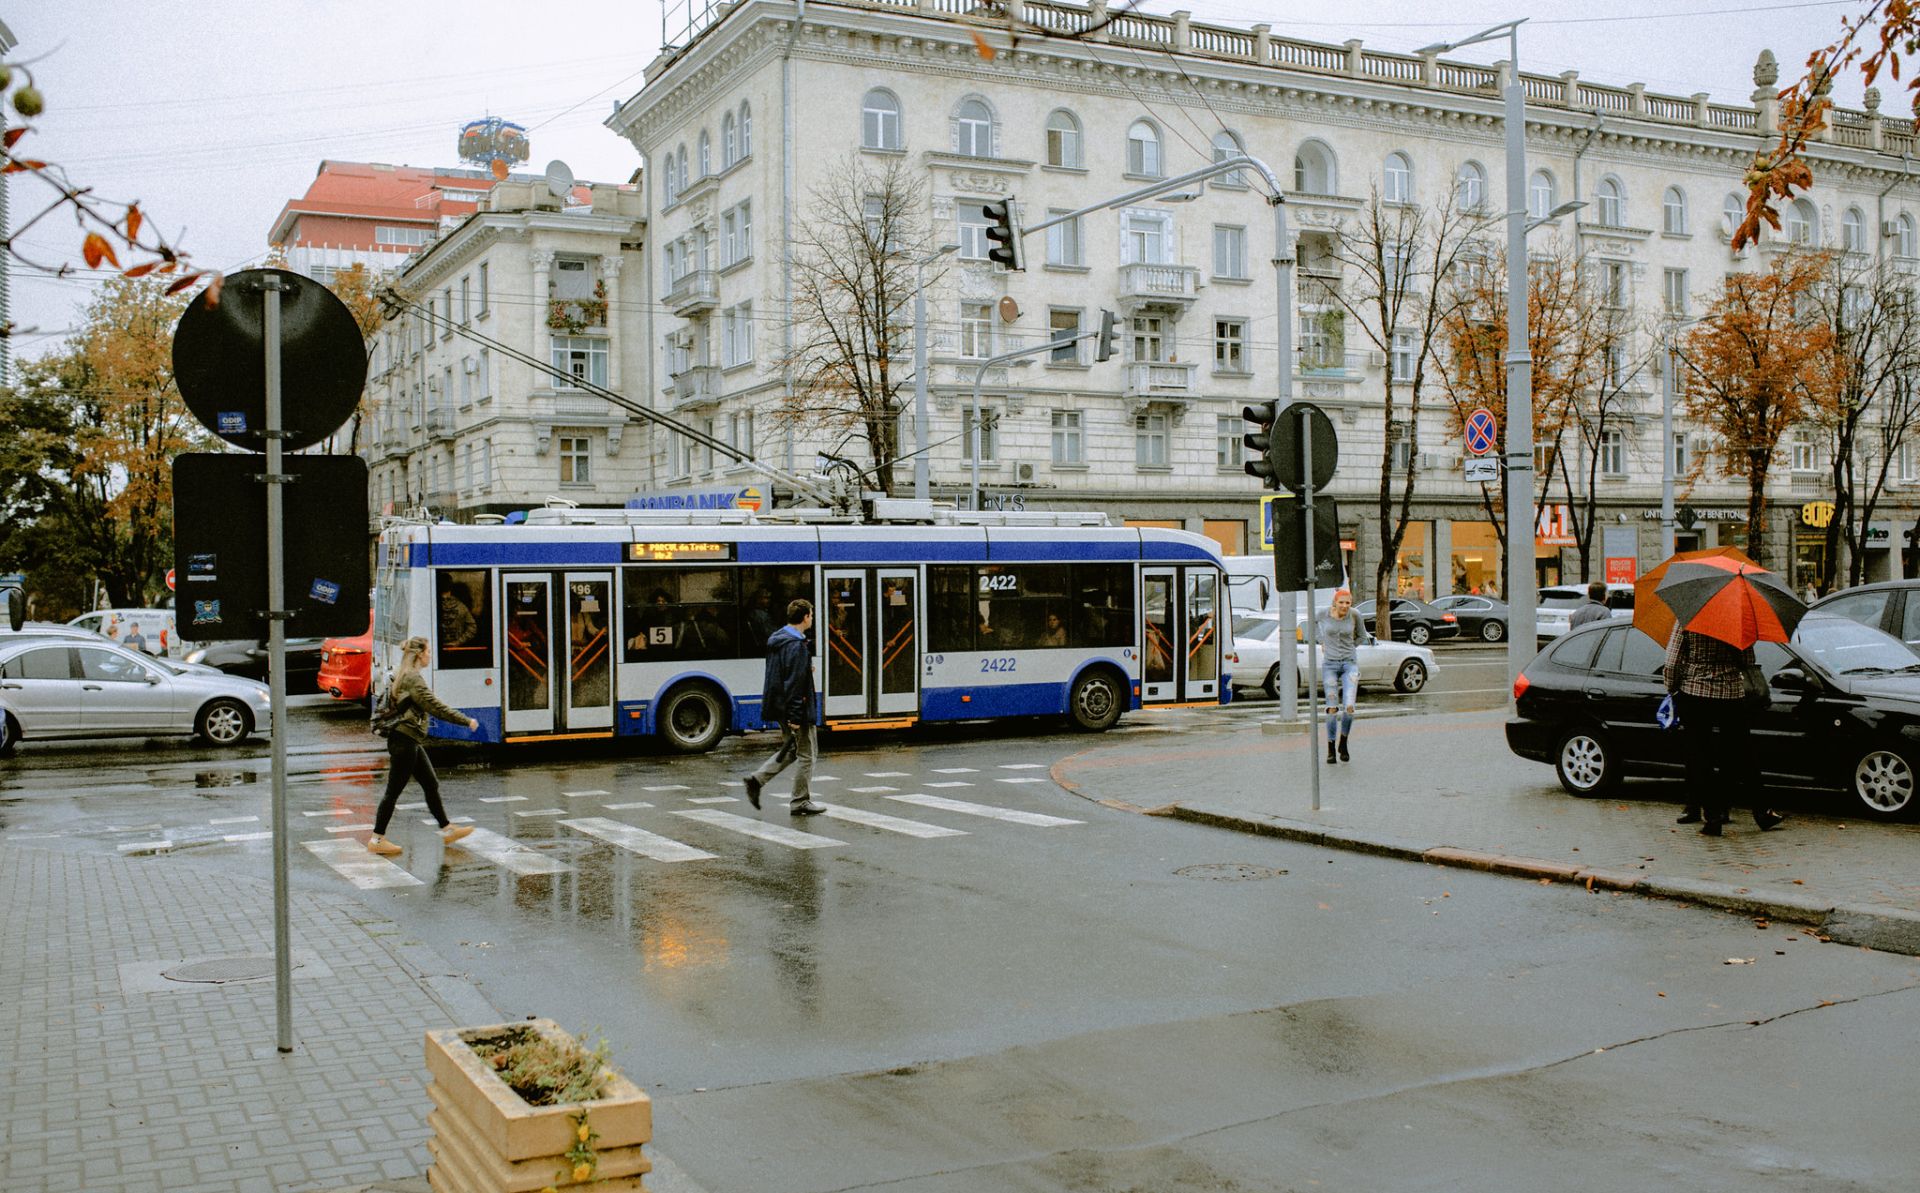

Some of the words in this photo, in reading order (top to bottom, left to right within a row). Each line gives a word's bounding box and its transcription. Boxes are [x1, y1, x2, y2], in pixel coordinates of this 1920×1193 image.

[1707, 510, 1741, 519] BENETTON
[636, 544, 645, 556] 5
[980, 575, 1016, 591] 2422
[656, 628, 666, 643] 5
[980, 658, 1016, 672] 2422
